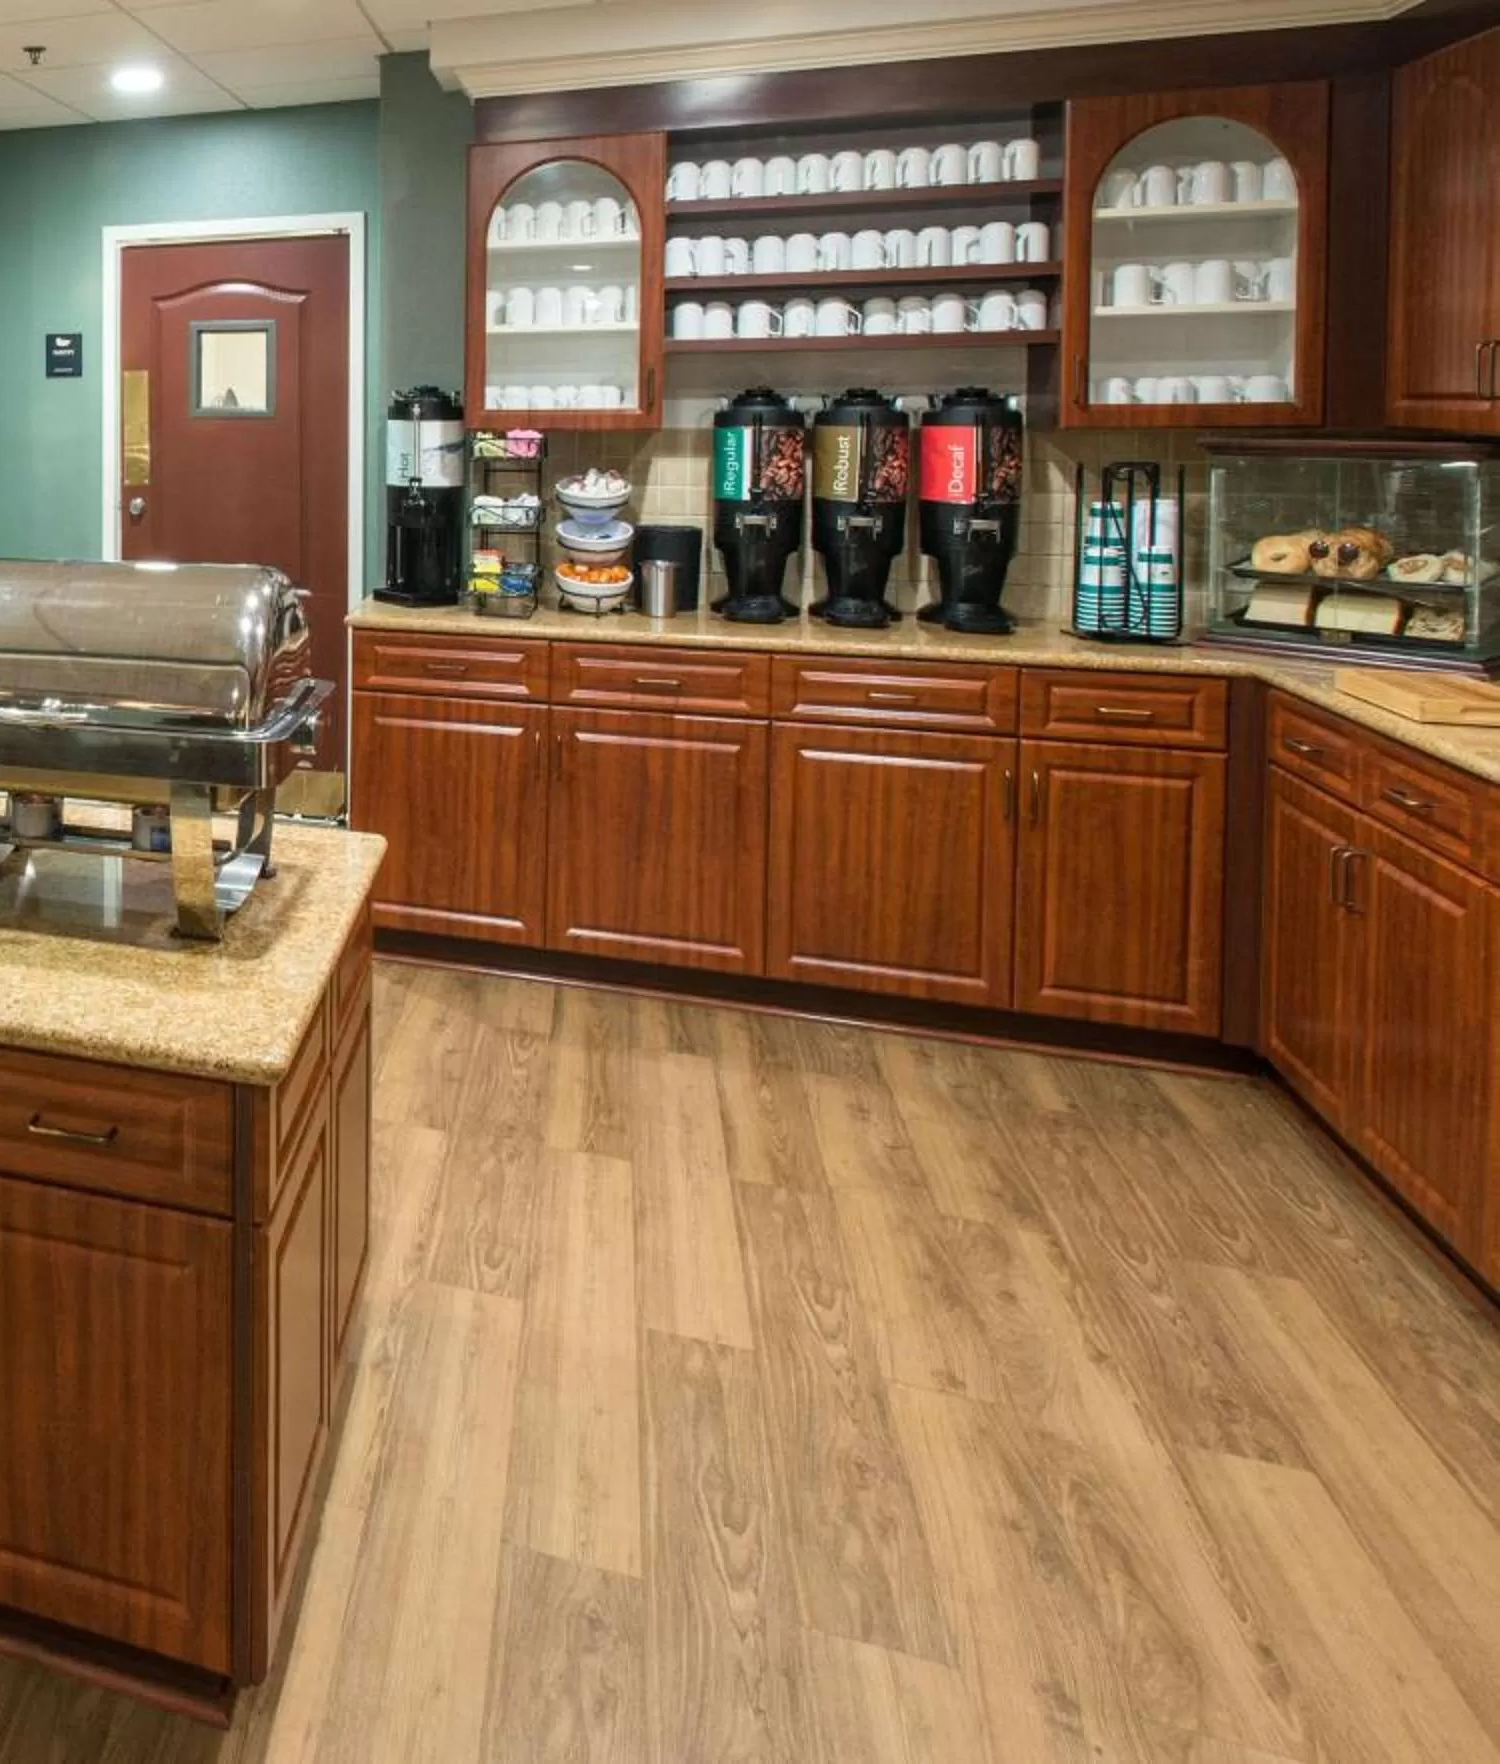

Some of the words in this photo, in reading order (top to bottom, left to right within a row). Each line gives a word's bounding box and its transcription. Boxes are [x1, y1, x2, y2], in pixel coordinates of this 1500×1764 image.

[723, 431, 739, 491] Regular
[833, 435, 851, 492] Robust
[947, 443, 965, 493] Decaf
